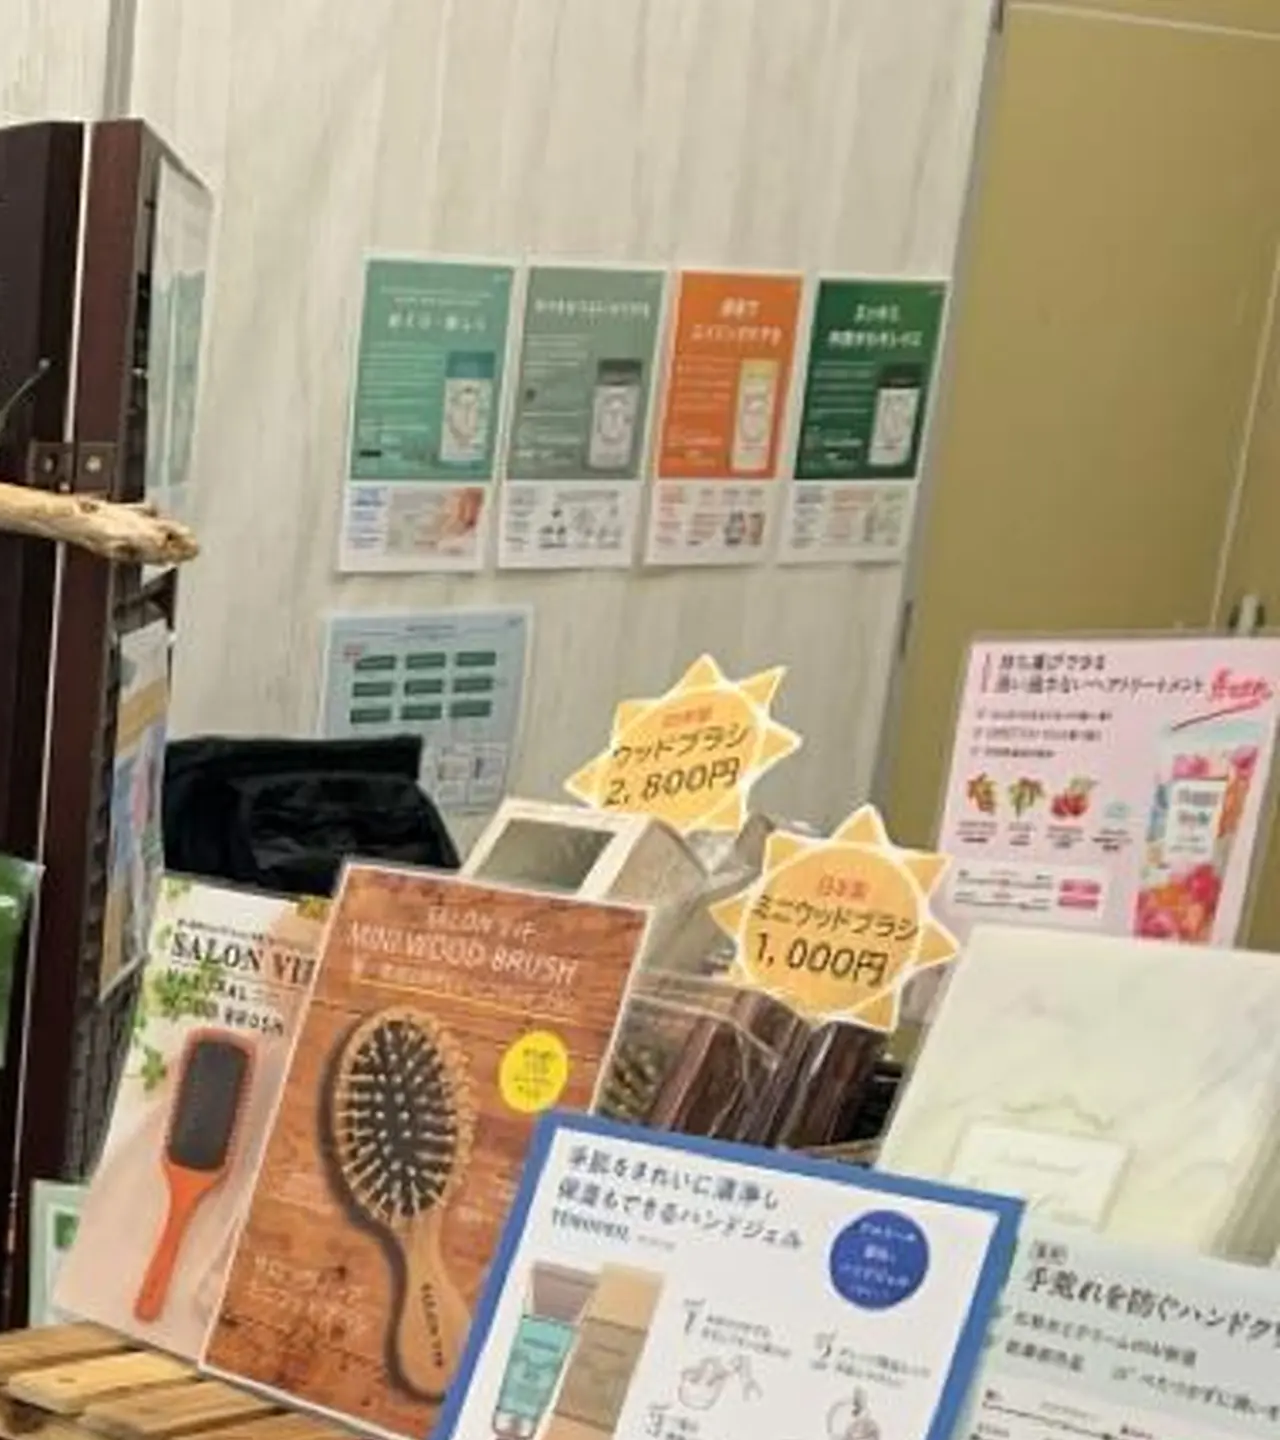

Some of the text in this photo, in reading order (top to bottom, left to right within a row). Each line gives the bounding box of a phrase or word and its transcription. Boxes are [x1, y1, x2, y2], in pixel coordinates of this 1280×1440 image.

[612, 724, 750, 767] ウッドブラシ
[603, 755, 740, 807] 2,800円
[750, 893, 920, 941] ミニウッドブラシ
[168, 930, 264, 978] SALON
[405, 932, 484, 969] WOOD
[491, 946, 578, 985] BRUSH
[755, 934, 888, 988] 1,000円
[1024, 1266, 1280, 1341] 手荒れを防ぐハンドク
